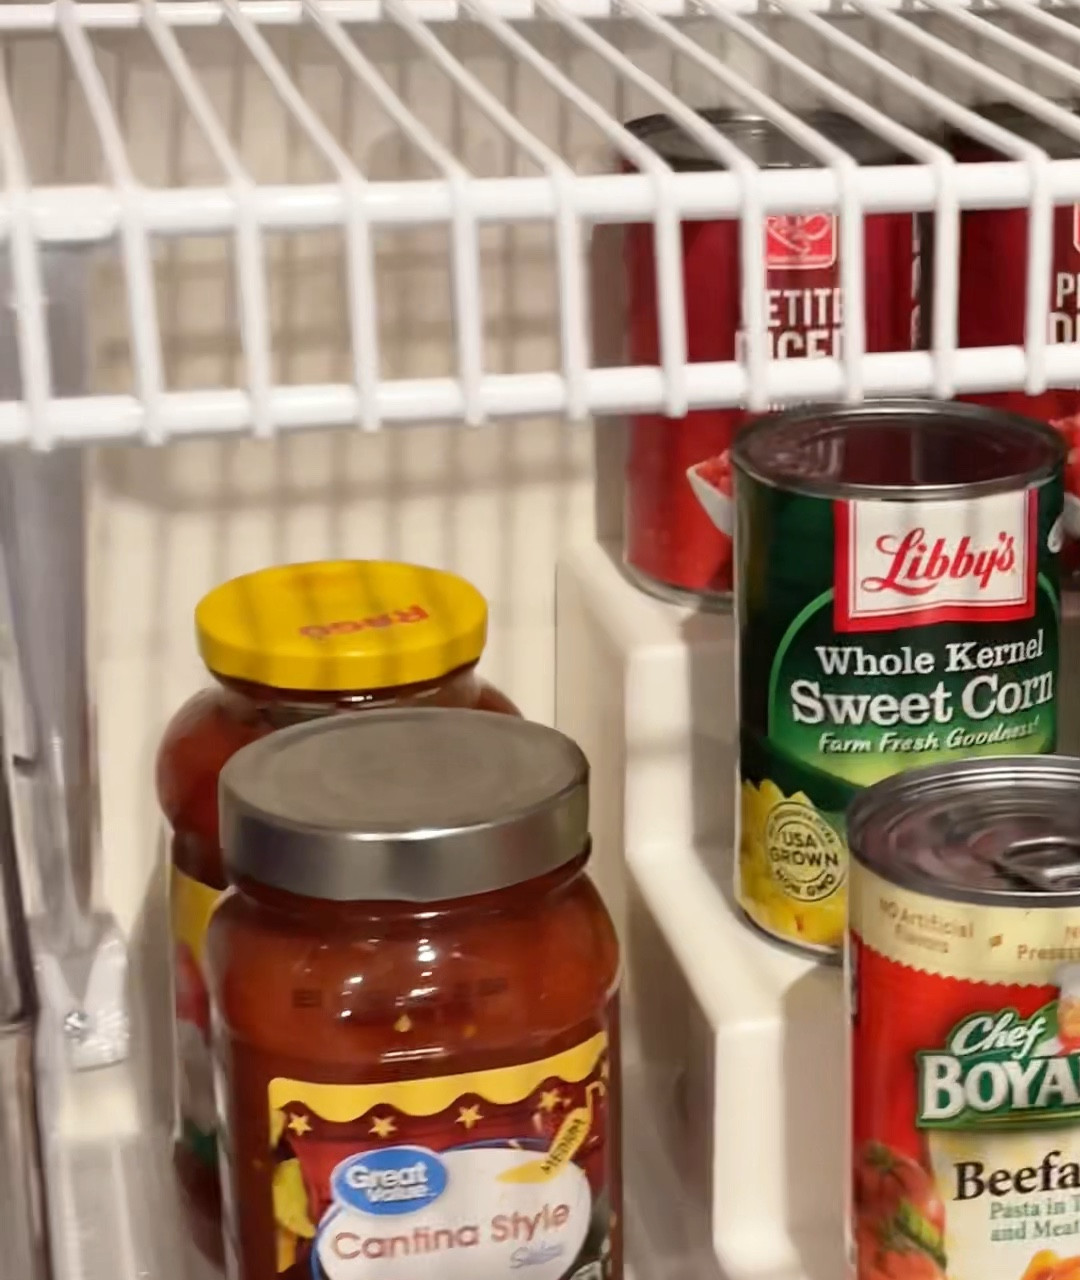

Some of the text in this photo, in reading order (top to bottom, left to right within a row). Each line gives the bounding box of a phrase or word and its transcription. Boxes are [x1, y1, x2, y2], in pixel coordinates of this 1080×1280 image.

[860, 527, 1016, 596] Libby's
[815, 628, 1045, 677] Whole Kernel
[789, 669, 1054, 726] Sweet Corn
[817, 716, 1040, 756] Farm Fresh Goodness!
[770, 846, 839, 867] GROWN
[782, 831, 818, 849] USA
[950, 1010, 1047, 1059] Chef
[346, 1161, 429, 1190] Great
[367, 1184, 430, 1204] Value
[989, 1200, 1041, 1220] Pasta
[1045, 1196, 1066, 1216] in
[333, 1203, 571, 1260] Cantina Style
[990, 1222, 1026, 1242] and
[1031, 1219, 1080, 1241] Meat
